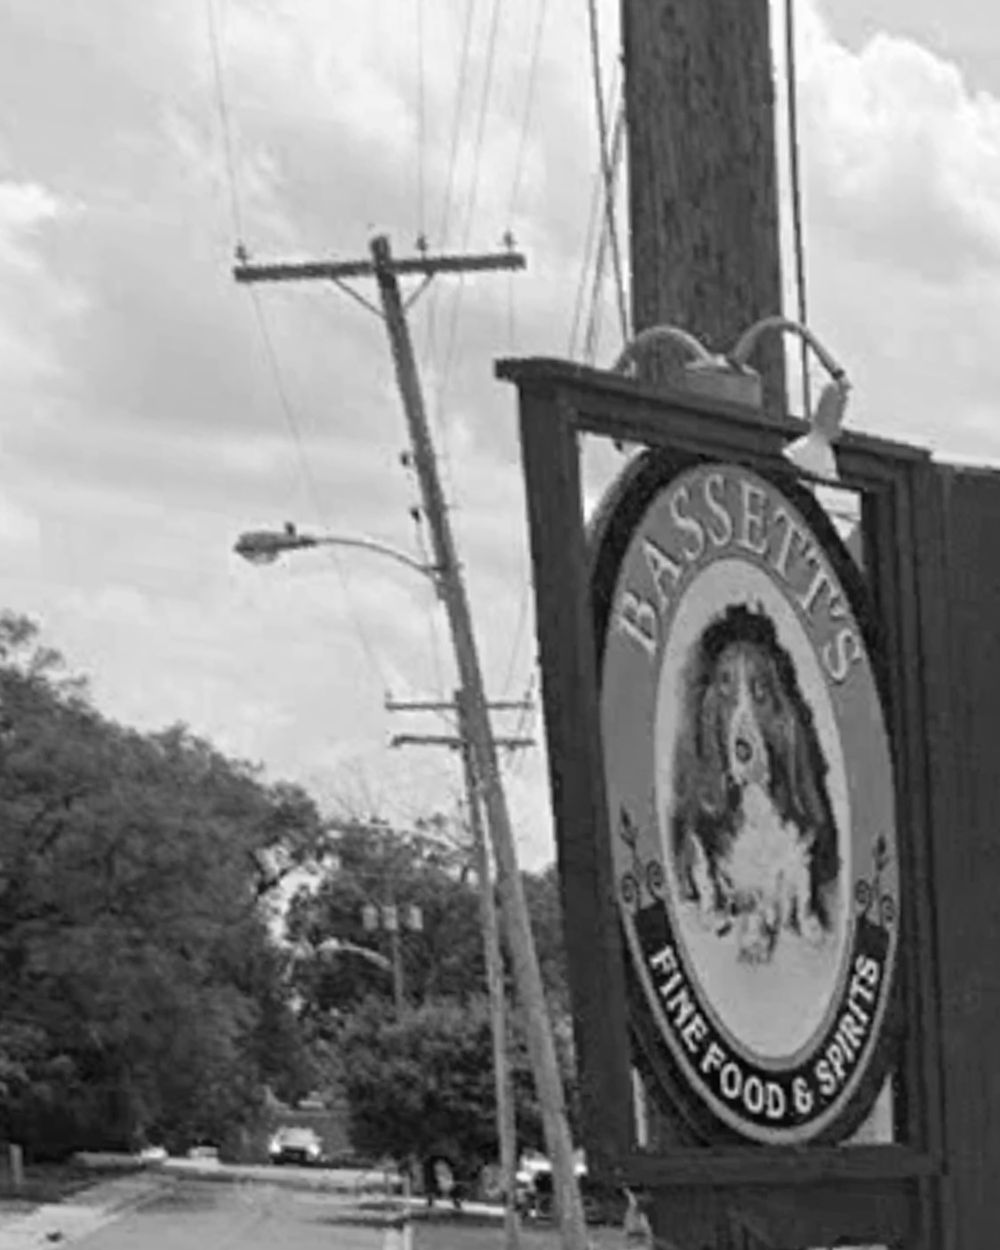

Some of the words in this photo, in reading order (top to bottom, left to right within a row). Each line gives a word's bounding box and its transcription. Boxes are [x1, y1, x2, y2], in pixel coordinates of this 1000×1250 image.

[617, 473, 862, 683] BASSETT'S
[650, 945, 709, 1052] FINE
[702, 1043, 785, 1119] FOOD
[792, 1077, 813, 1115] &
[815, 954, 880, 1096] SPIRITS
